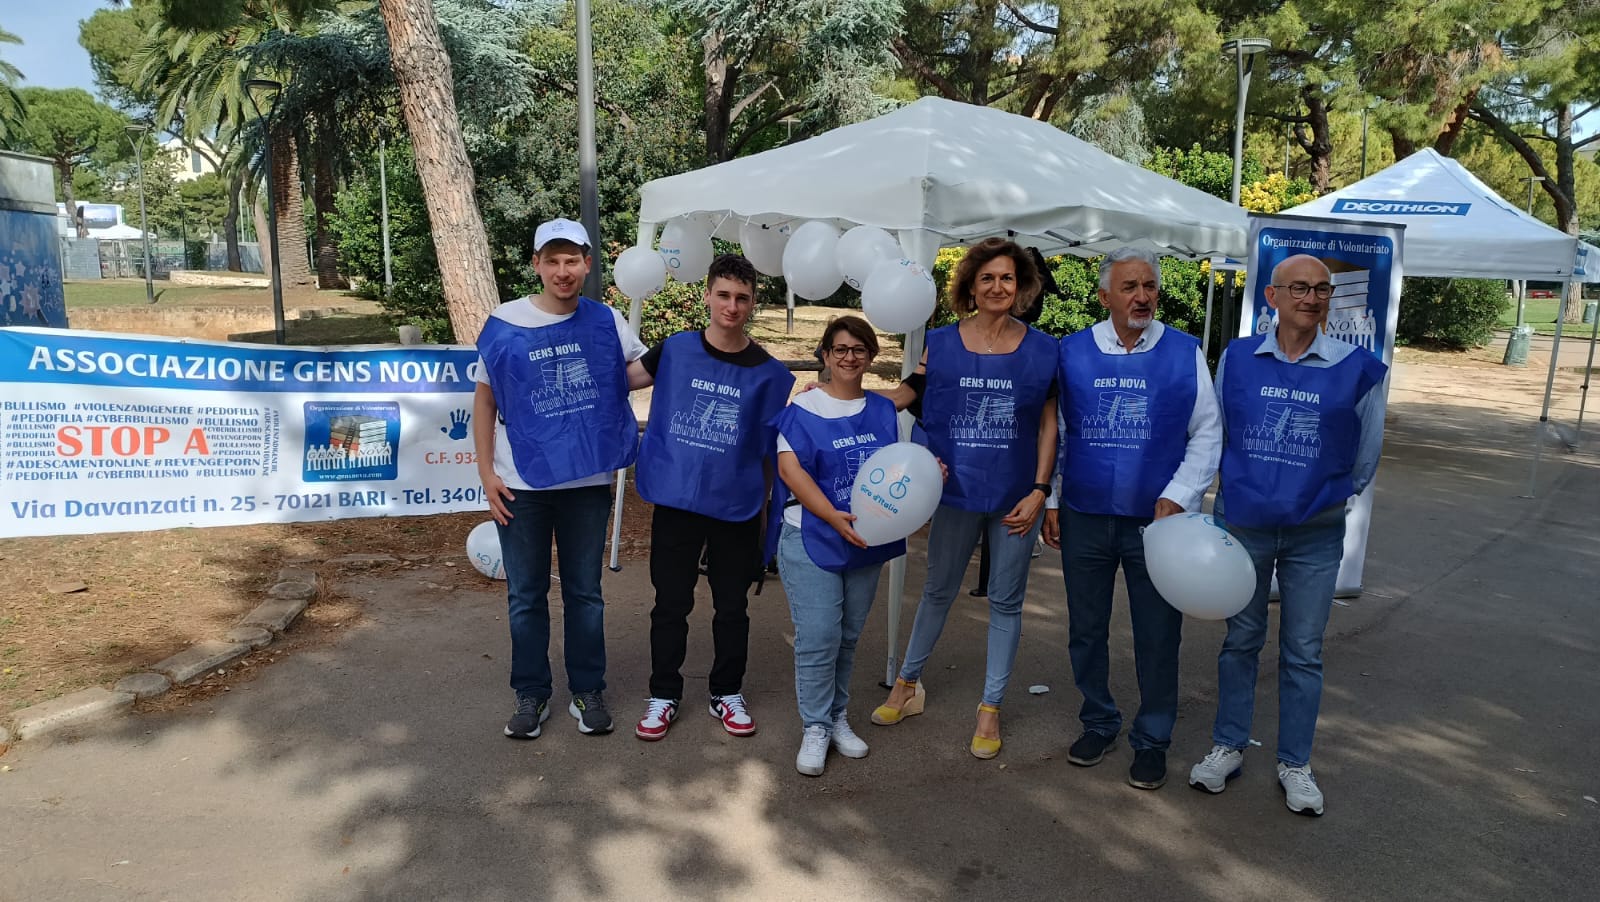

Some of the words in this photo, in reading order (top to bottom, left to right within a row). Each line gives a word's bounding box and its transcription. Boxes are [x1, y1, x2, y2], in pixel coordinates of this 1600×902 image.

[1342, 201, 1460, 214] DECATHLON
[1262, 234, 1327, 250] Organizzazione
[1327, 239, 1336, 251] di
[1338, 240, 1390, 254] Volontariato
[1326, 319, 1373, 332] NOVA
[529, 347, 554, 361] GENS
[555, 343, 581, 356] NOVA
[28, 345, 285, 382] ASSOCIAZIONE
[293, 360, 371, 383] GENS
[380, 361, 460, 383] NOVA
[691, 378, 715, 392] GENS
[717, 384, 741, 398] NOVA
[959, 377, 984, 388] GENS
[986, 379, 1013, 390] NOVA
[1094, 378, 1117, 388] GENS
[1119, 379, 1146, 389] NOVA
[1260, 386, 1288, 399] GENS
[1291, 389, 1320, 404] NOVA
[0, 401, 66, 411] BULLISMO
[75, 402, 193, 415] #VIOLENZADIGENERE
[198, 406, 259, 416] #PEDOFILIA
[11, 413, 83, 423] #PEDOFILIA
[87, 414, 189, 425] #CYBERBULLISMO
[197, 417, 258, 427] #BULLISMO
[57, 425, 170, 457] STOP
[184, 427, 209, 456] A
[832, 437, 856, 449] GENS
[856, 433, 877, 444] NOVA
[7, 459, 151, 469] #ADESCAMENTONLINE
[155, 458, 260, 467] #REVENGEPORN
[425, 452, 451, 465] C.F.
[7, 471, 79, 481] #PEDOFILIA
[88, 469, 189, 480] #CYBERBULLISMO
[196, 468, 256, 478] #BULLISMO
[11, 500, 56, 518] Via
[65, 496, 196, 518] Davanzati
[203, 497, 225, 512] n.
[231, 496, 256, 511] 25
[275, 493, 332, 510] 70121
[338, 490, 386, 507] BARI
[402, 488, 436, 505] Tel.
